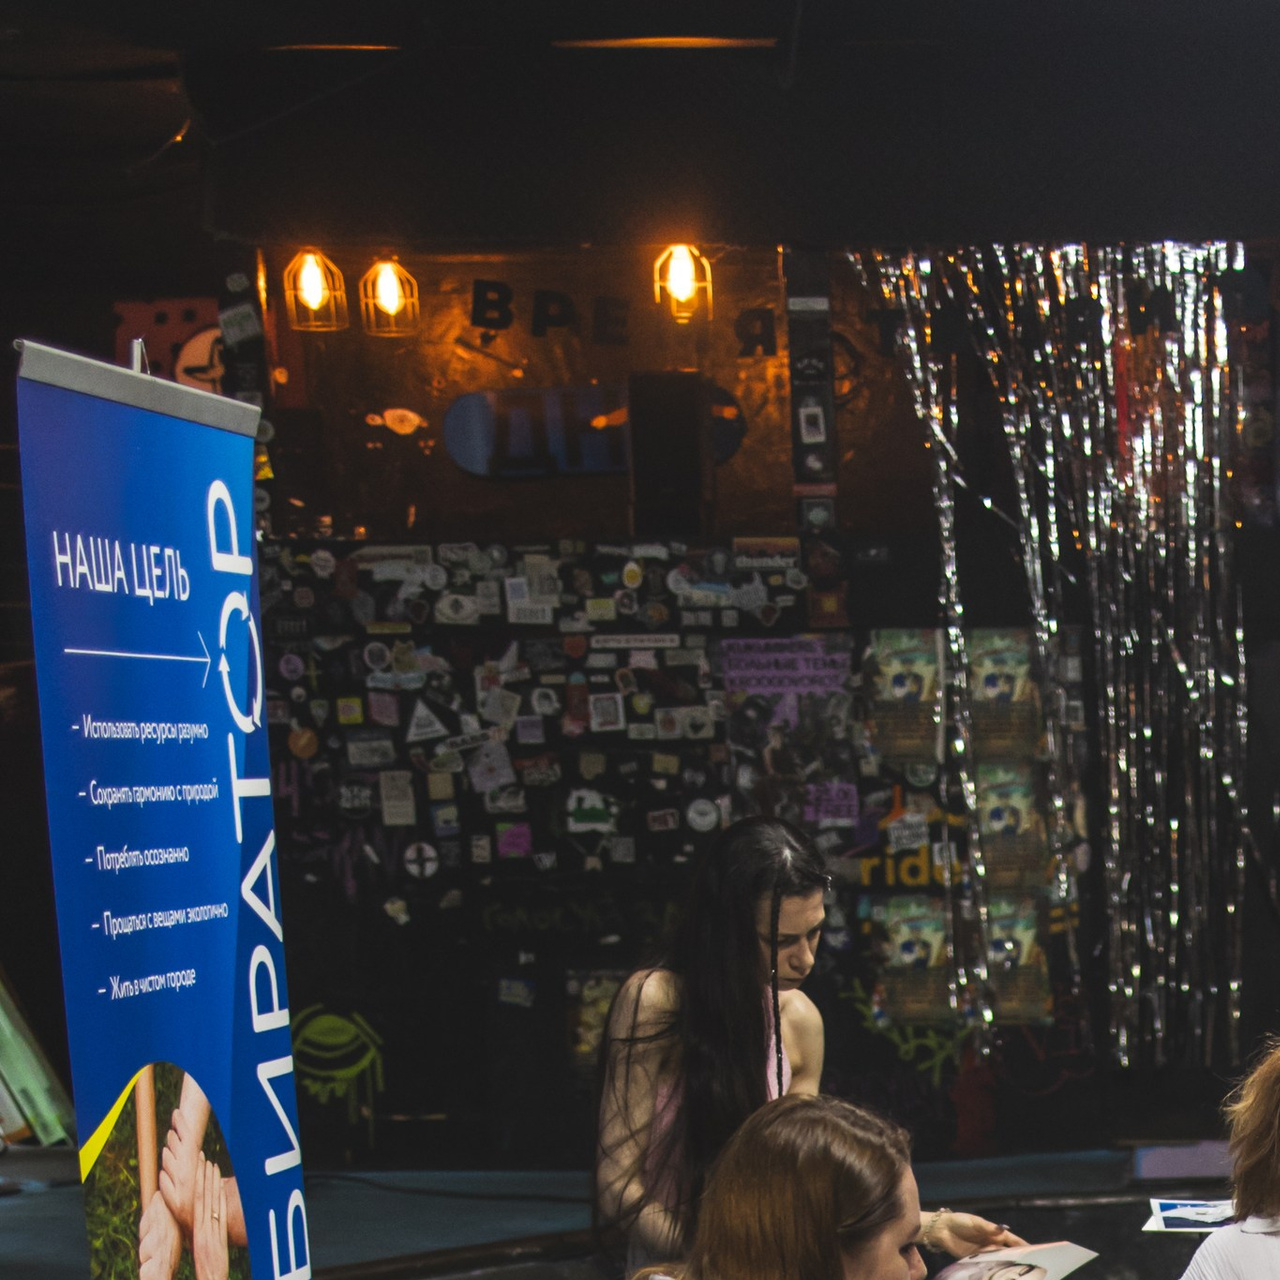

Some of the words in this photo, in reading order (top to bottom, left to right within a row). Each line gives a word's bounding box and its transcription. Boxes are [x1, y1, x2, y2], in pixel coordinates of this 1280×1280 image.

[53, 530, 129, 595] НАША
[130, 543, 190, 606] ЦЕЛЬ
[82, 713, 139, 738] Использовать
[140, 722, 177, 744] ресурсы
[178, 722, 209, 744] разумно
[90, 779, 132, 810] Сохранять
[132, 784, 176, 808] гармонию
[176, 785, 182, 800] с
[182, 776, 219, 806] природой
[96, 843, 144, 875] Потреблять
[144, 846, 190, 866] осознанно
[103, 911, 147, 940] Прощаться
[147, 914, 153, 929] с
[153, 908, 187, 929] вещами
[187, 902, 229, 924] экологично
[109, 975, 134, 1000] Жить
[134, 980, 139, 996] в
[139, 974, 167, 993] чистом
[166, 968, 196, 992] городе
